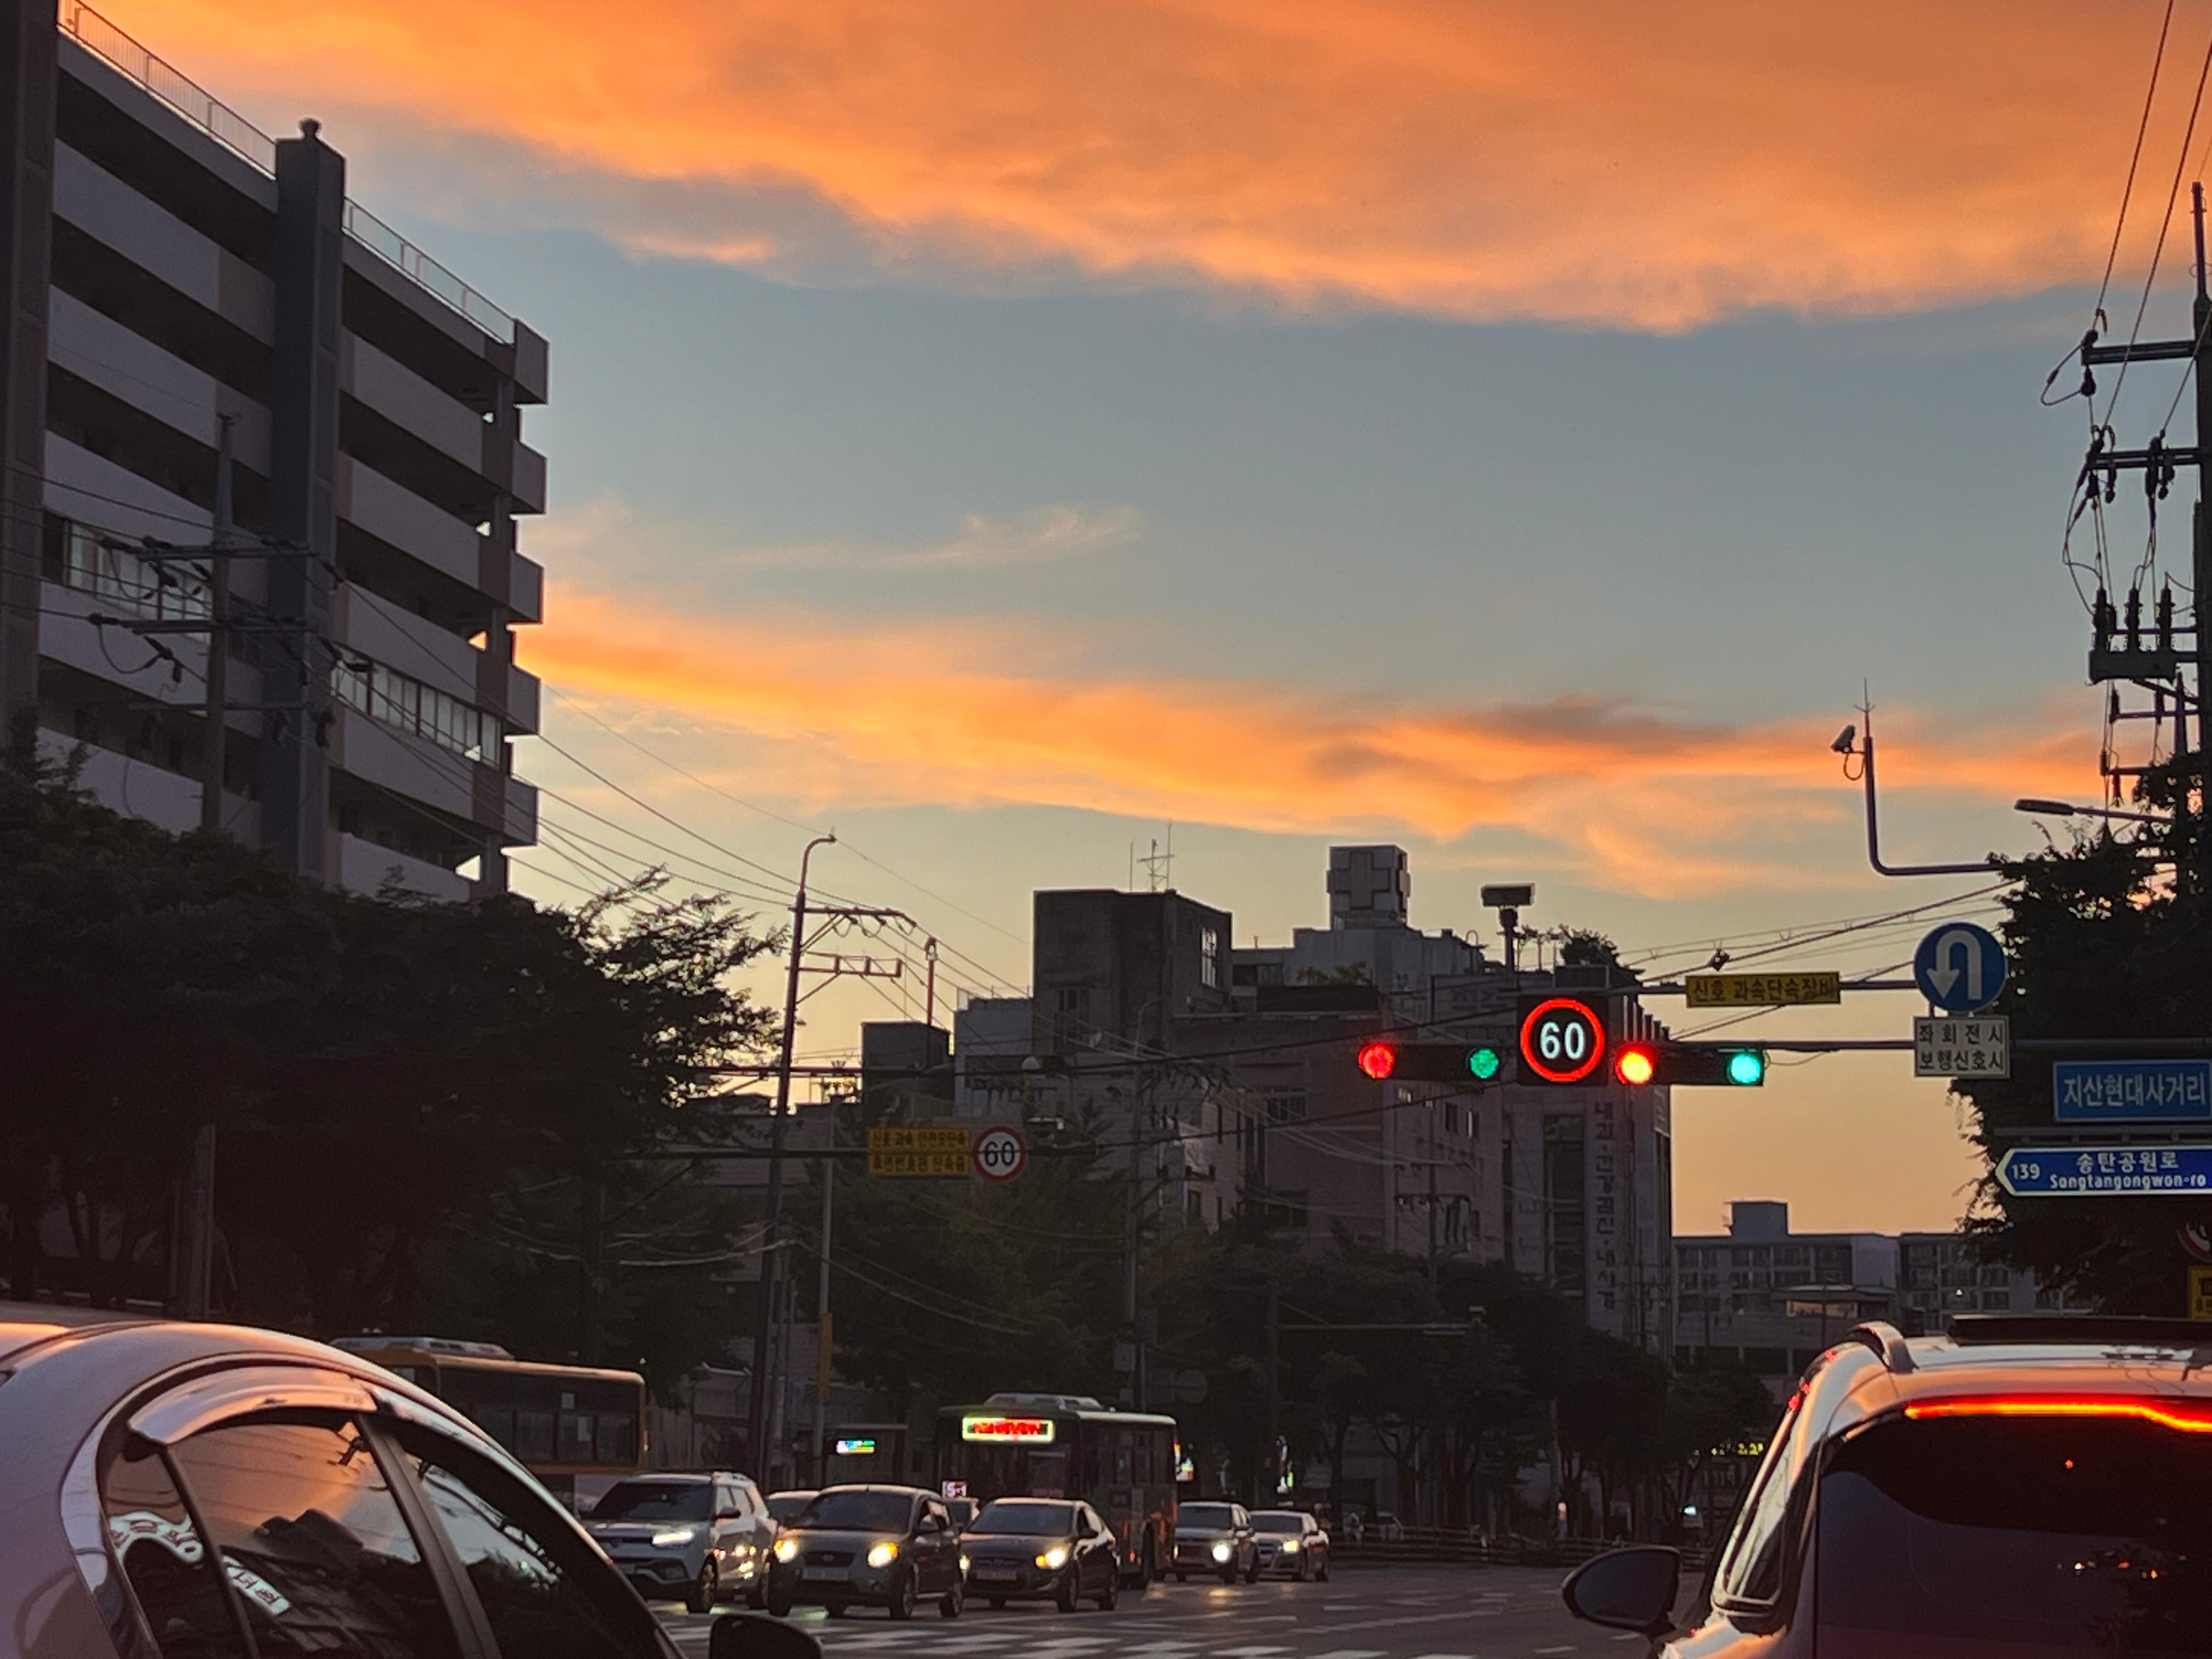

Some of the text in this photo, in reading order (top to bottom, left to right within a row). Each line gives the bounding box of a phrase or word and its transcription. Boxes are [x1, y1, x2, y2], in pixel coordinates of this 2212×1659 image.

[1694, 977, 1834, 1002] 신호 과속단속장비
[1540, 1022, 1585, 1060] 60
[1919, 1050, 2004, 1071] 보행신호시
[2063, 1071, 2207, 1108] 지산현대사거리
[984, 1140, 1014, 1167] 60
[2076, 1151, 2179, 1174] 송탄공원로
[2011, 1163, 2041, 1180] 139
[2050, 1173, 2207, 1192] Songtangongwon-ro
